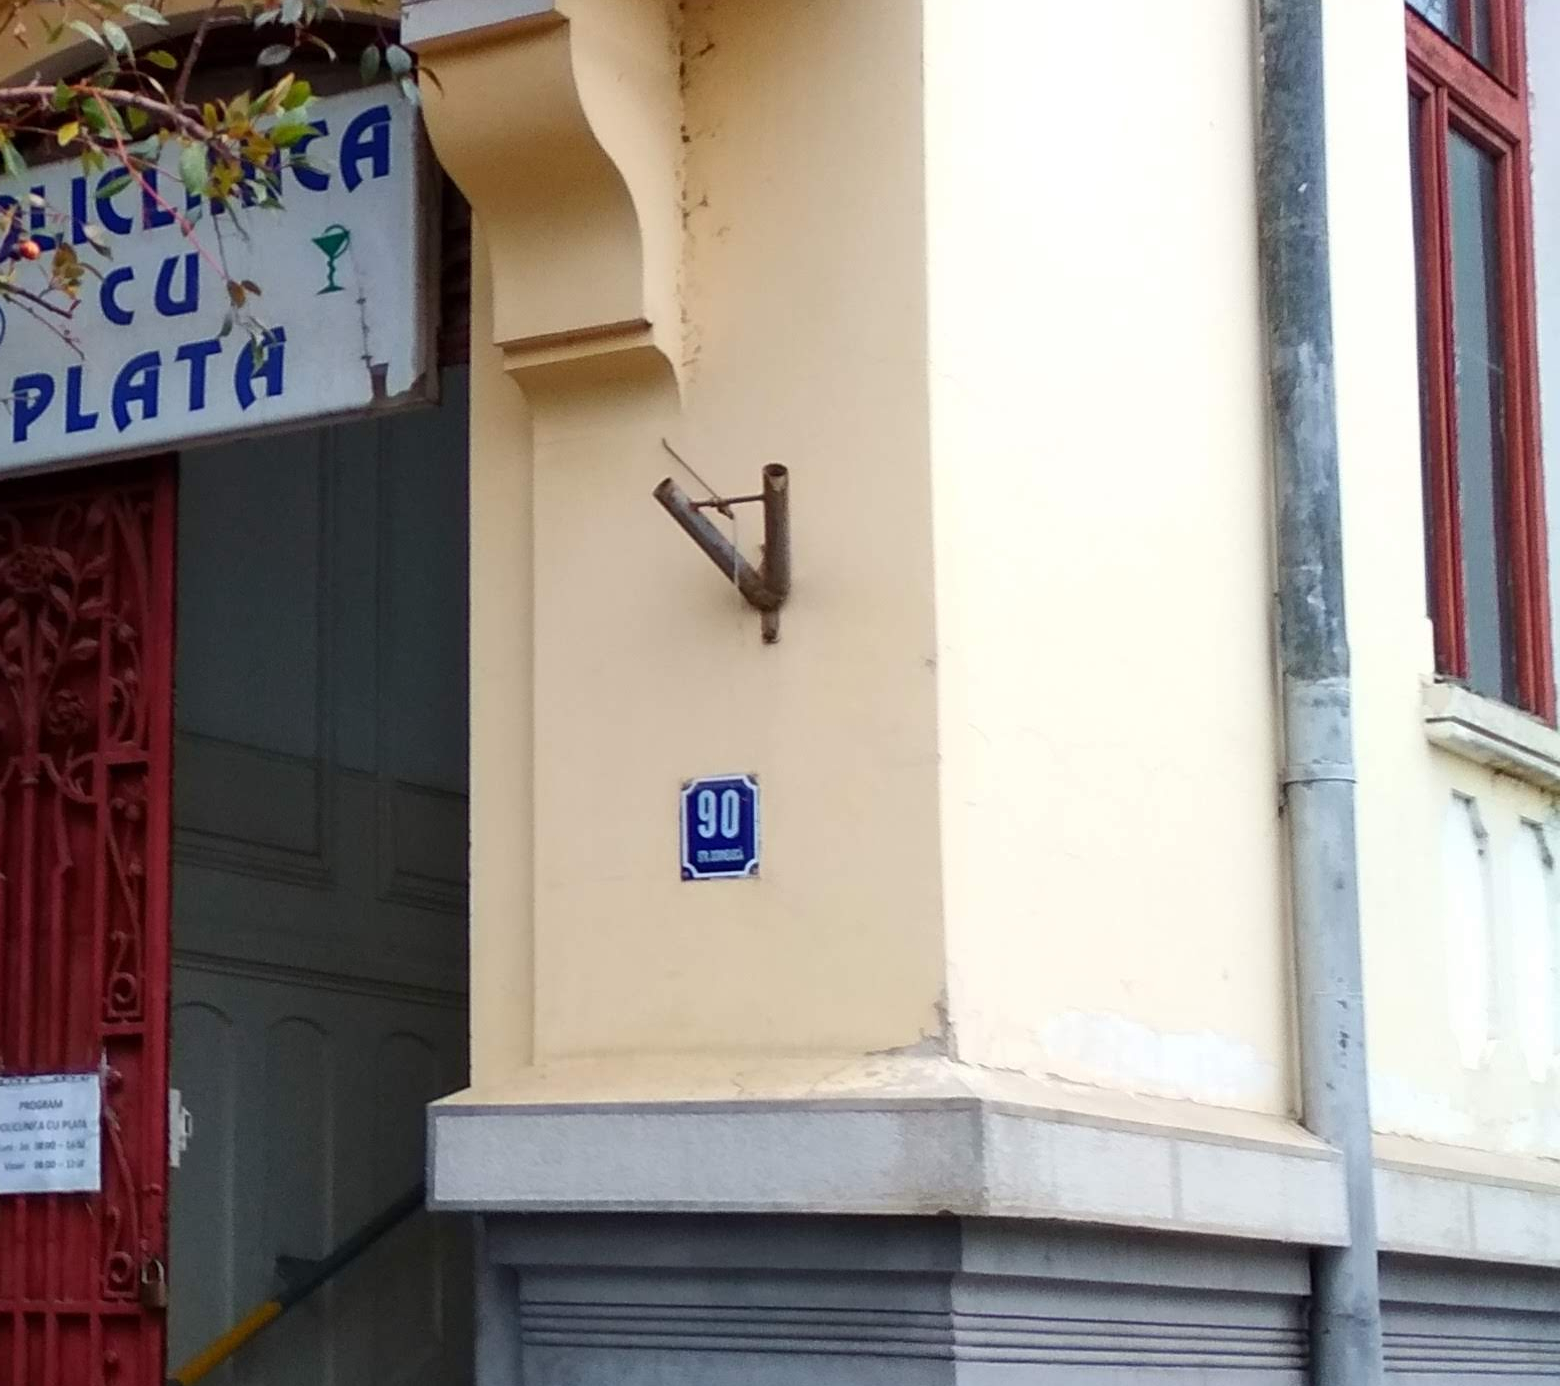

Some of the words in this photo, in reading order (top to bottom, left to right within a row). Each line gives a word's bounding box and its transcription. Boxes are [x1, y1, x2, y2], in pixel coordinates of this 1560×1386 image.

[99, 253, 200, 325] CU
[12, 326, 286, 442] PLATA
[697, 789, 739, 838] 90
